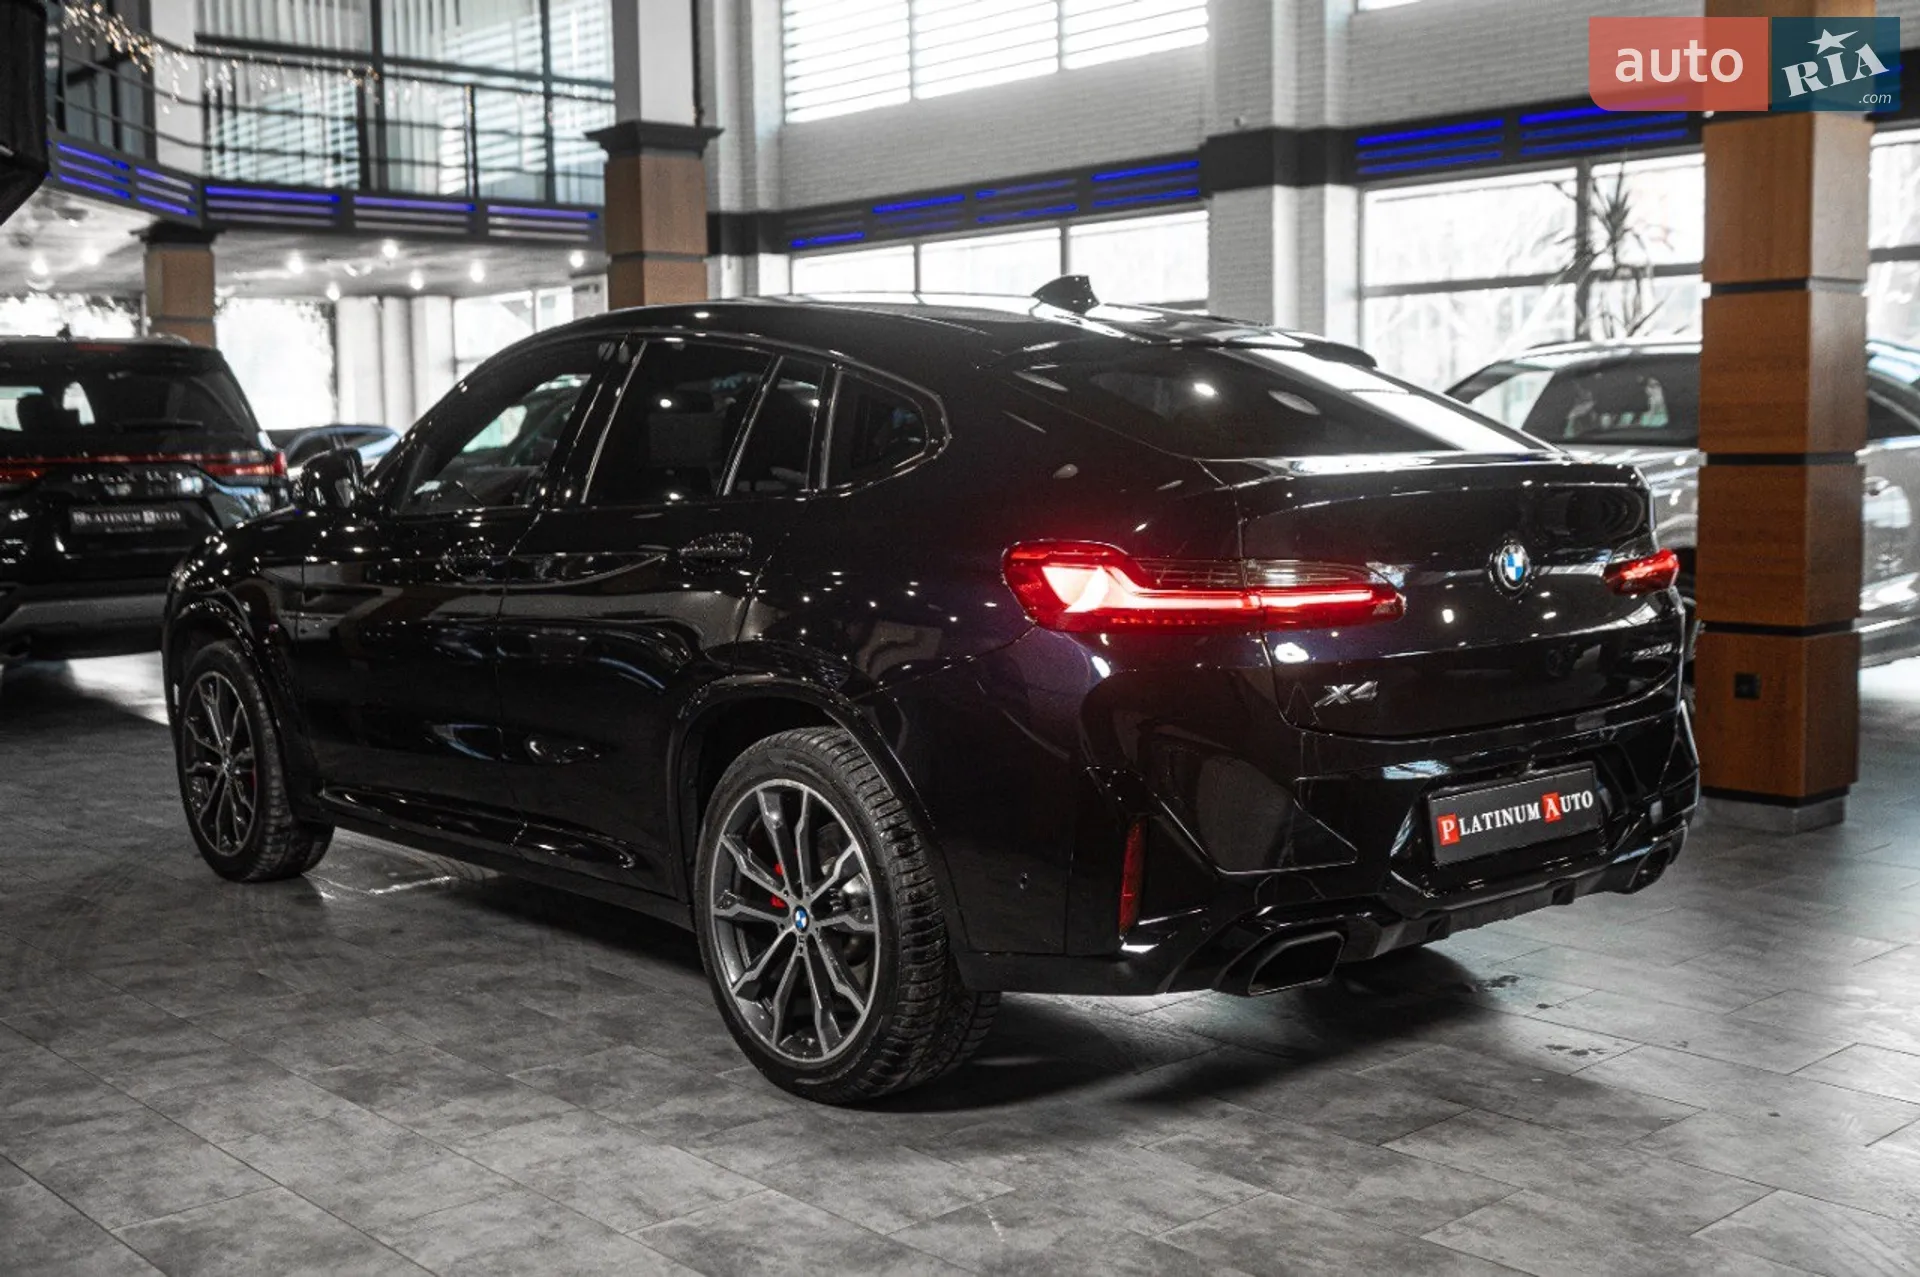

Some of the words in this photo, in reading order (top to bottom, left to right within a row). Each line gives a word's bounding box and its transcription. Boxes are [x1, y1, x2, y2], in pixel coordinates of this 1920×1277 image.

[1314, 681, 1378, 707] X4
[1438, 802, 1541, 844] PLATINUM
[1543, 790, 1594, 822] AUTO
